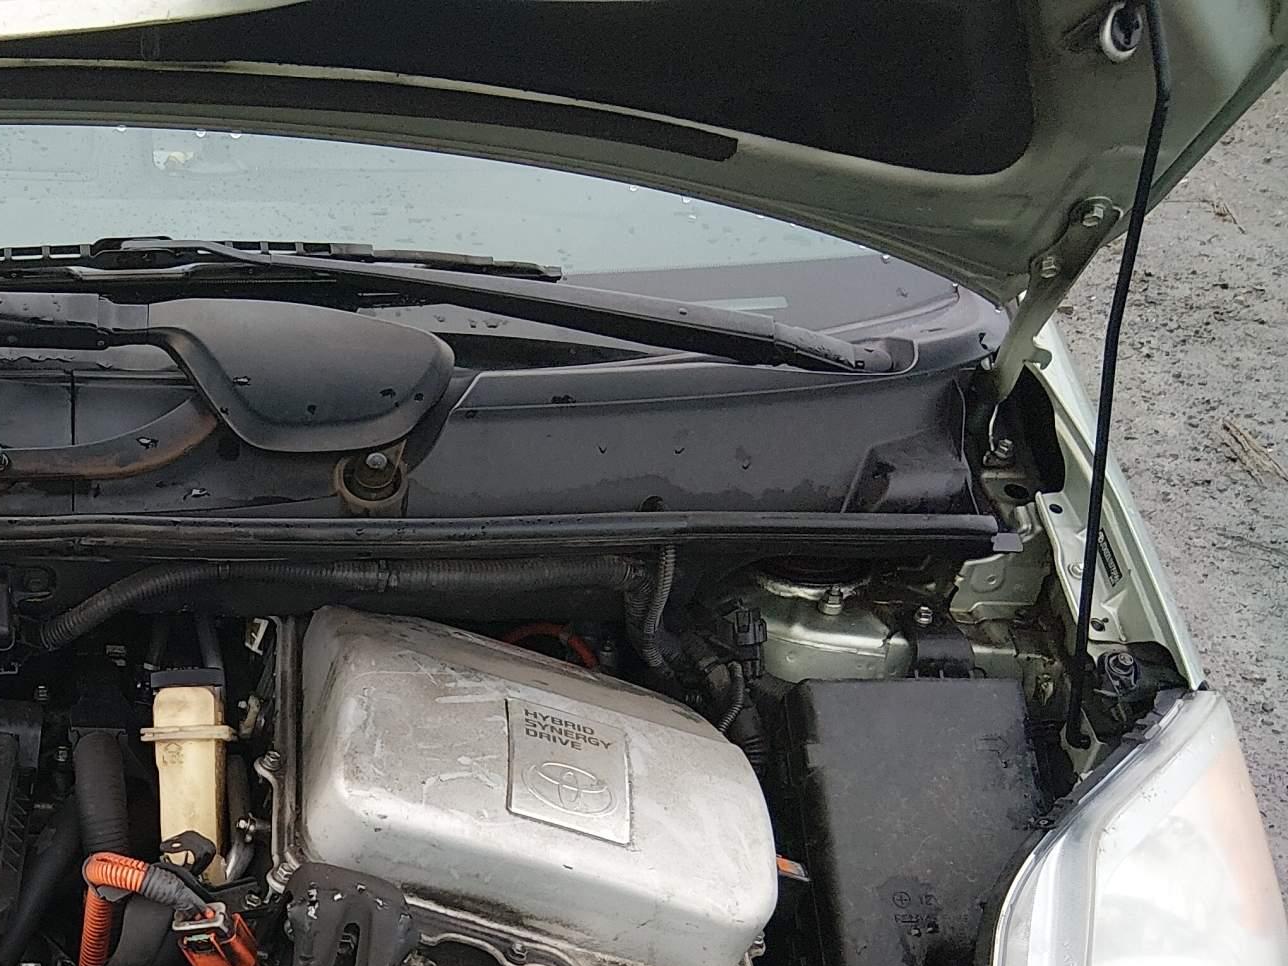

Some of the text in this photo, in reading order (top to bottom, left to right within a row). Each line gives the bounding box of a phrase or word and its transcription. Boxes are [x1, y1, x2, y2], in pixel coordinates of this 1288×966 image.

[524, 708, 594, 735] HYBRID
[524, 718, 612, 749] SYNERGY
[525, 728, 582, 751] DRIVE
